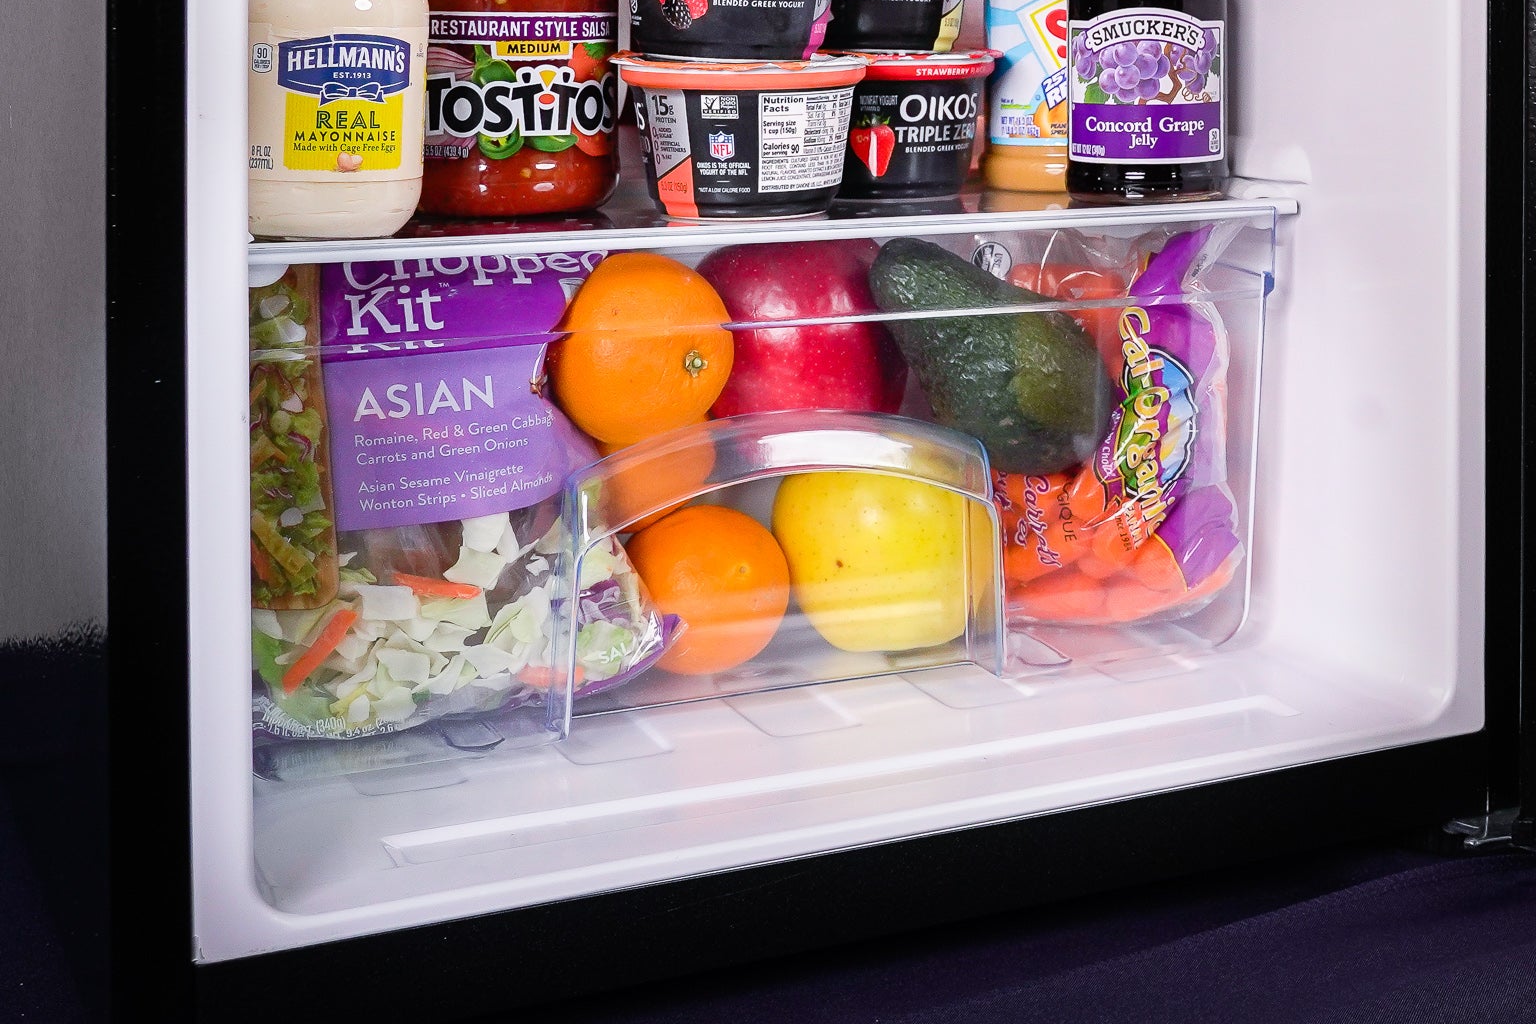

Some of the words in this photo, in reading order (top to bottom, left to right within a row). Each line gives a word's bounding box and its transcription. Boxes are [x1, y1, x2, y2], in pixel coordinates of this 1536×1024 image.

[751, 0, 777, 8] GREEK
[779, 0, 805, 9] YOGURT
[431, 18, 531, 38] RESTAURANT
[534, 19, 578, 38] STYLE
[582, 20, 610, 37] SALSA
[1092, 20, 1199, 46] SMUCKER'S
[257, 48, 268, 58] 90
[507, 42, 561, 54] MEDIUM
[287, 45, 405, 73] HELLMANN'S
[916, 68, 969, 76] STRAWBERRY
[426, 72, 614, 137] TOSTITOS
[900, 93, 977, 122] OIKOS
[316, 110, 380, 129] REAL
[1085, 116, 1152, 133] Concord
[1159, 117, 1204, 135] Grape
[294, 130, 396, 142] MAYONNAISE
[1129, 133, 1158, 149] Jelly
[293, 143, 317, 151] Made
[318, 142, 337, 151] with
[340, 143, 361, 154] Cage
[381, 144, 396, 153] Eggs
[713, 144, 731, 156] NFL
[791, 144, 799, 154] 90
[353, 375, 495, 422] ASIAN
[354, 432, 419, 448] Romaine,
[422, 427, 449, 441] Red
[454, 425, 465, 437] &
[468, 422, 508, 436] Green
[356, 451, 407, 466] Carrots
[411, 447, 435, 460] and
[439, 442, 481, 457] Green
[484, 436, 529, 452] Onions
[358, 480, 395, 493] Asian
[400, 474, 451, 490] Sesame
[454, 463, 524, 485] Vinaigrette
[359, 496, 414, 512] Wonton
[417, 492, 457, 509] Strips
[470, 486, 507, 500] Sliced
[511, 474, 553, 494] Almonds
